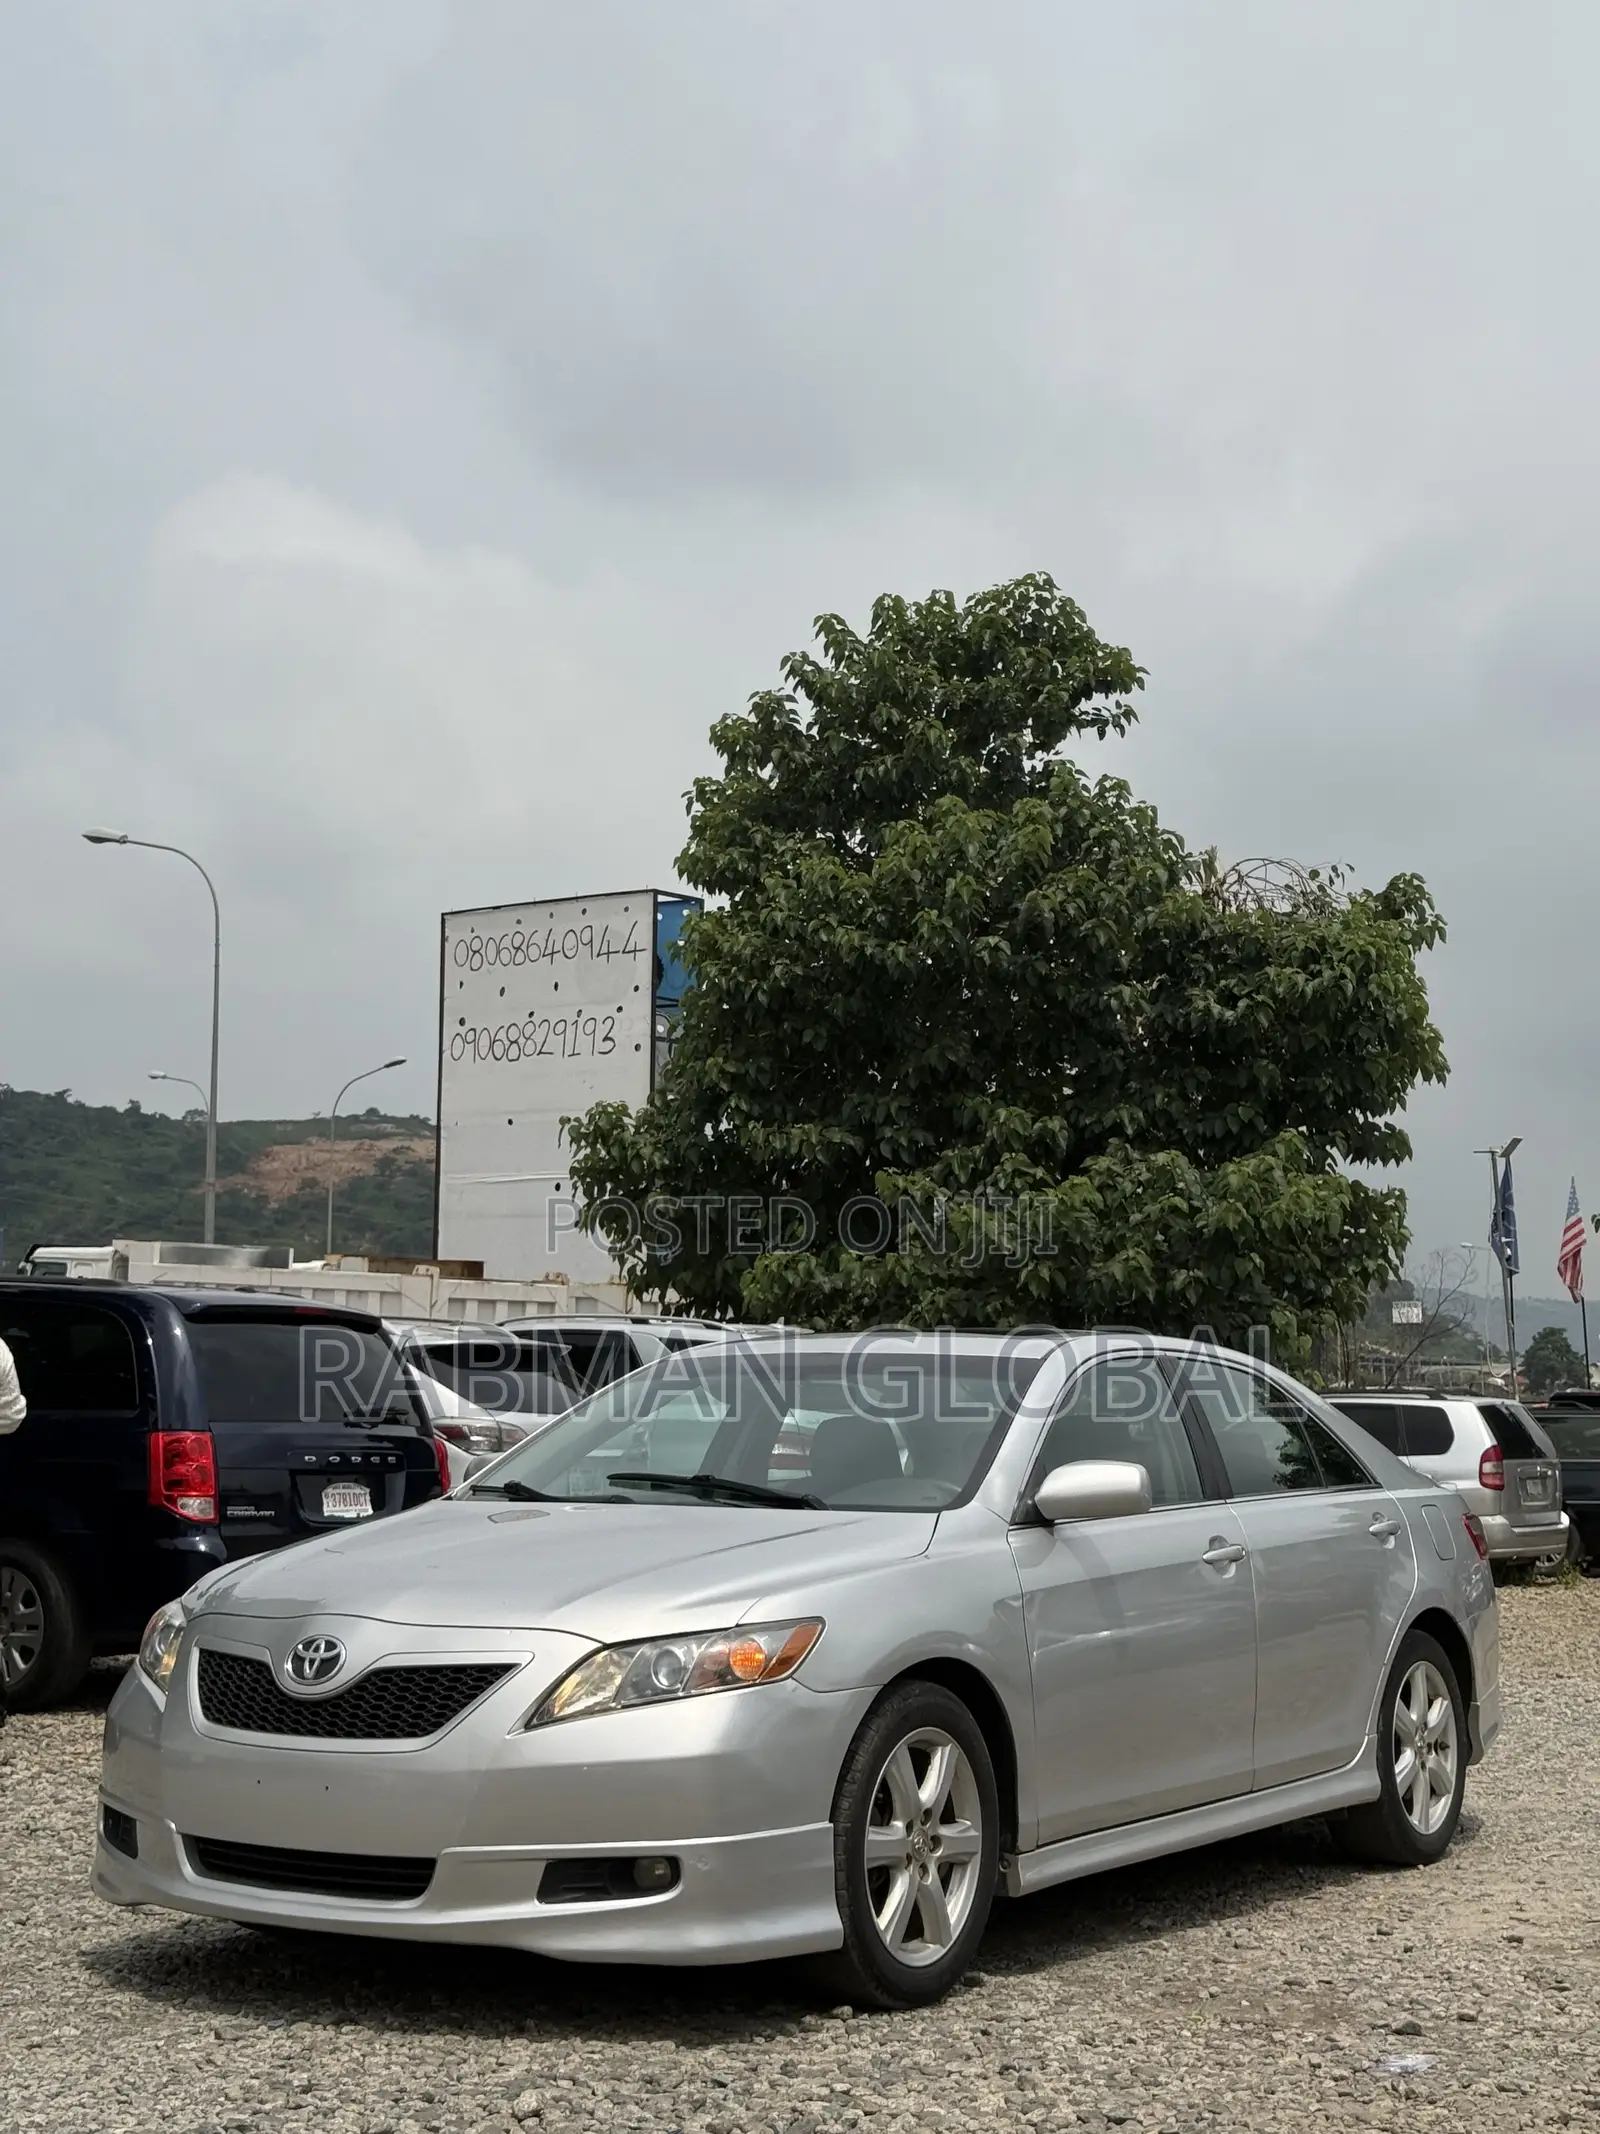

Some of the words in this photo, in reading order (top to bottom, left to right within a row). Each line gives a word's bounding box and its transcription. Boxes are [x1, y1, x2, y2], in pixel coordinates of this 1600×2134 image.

[454, 920, 647, 972] 08068640944
[450, 1016, 616, 1063] 09068829193
[304, 1455, 397, 1464] DODGE
